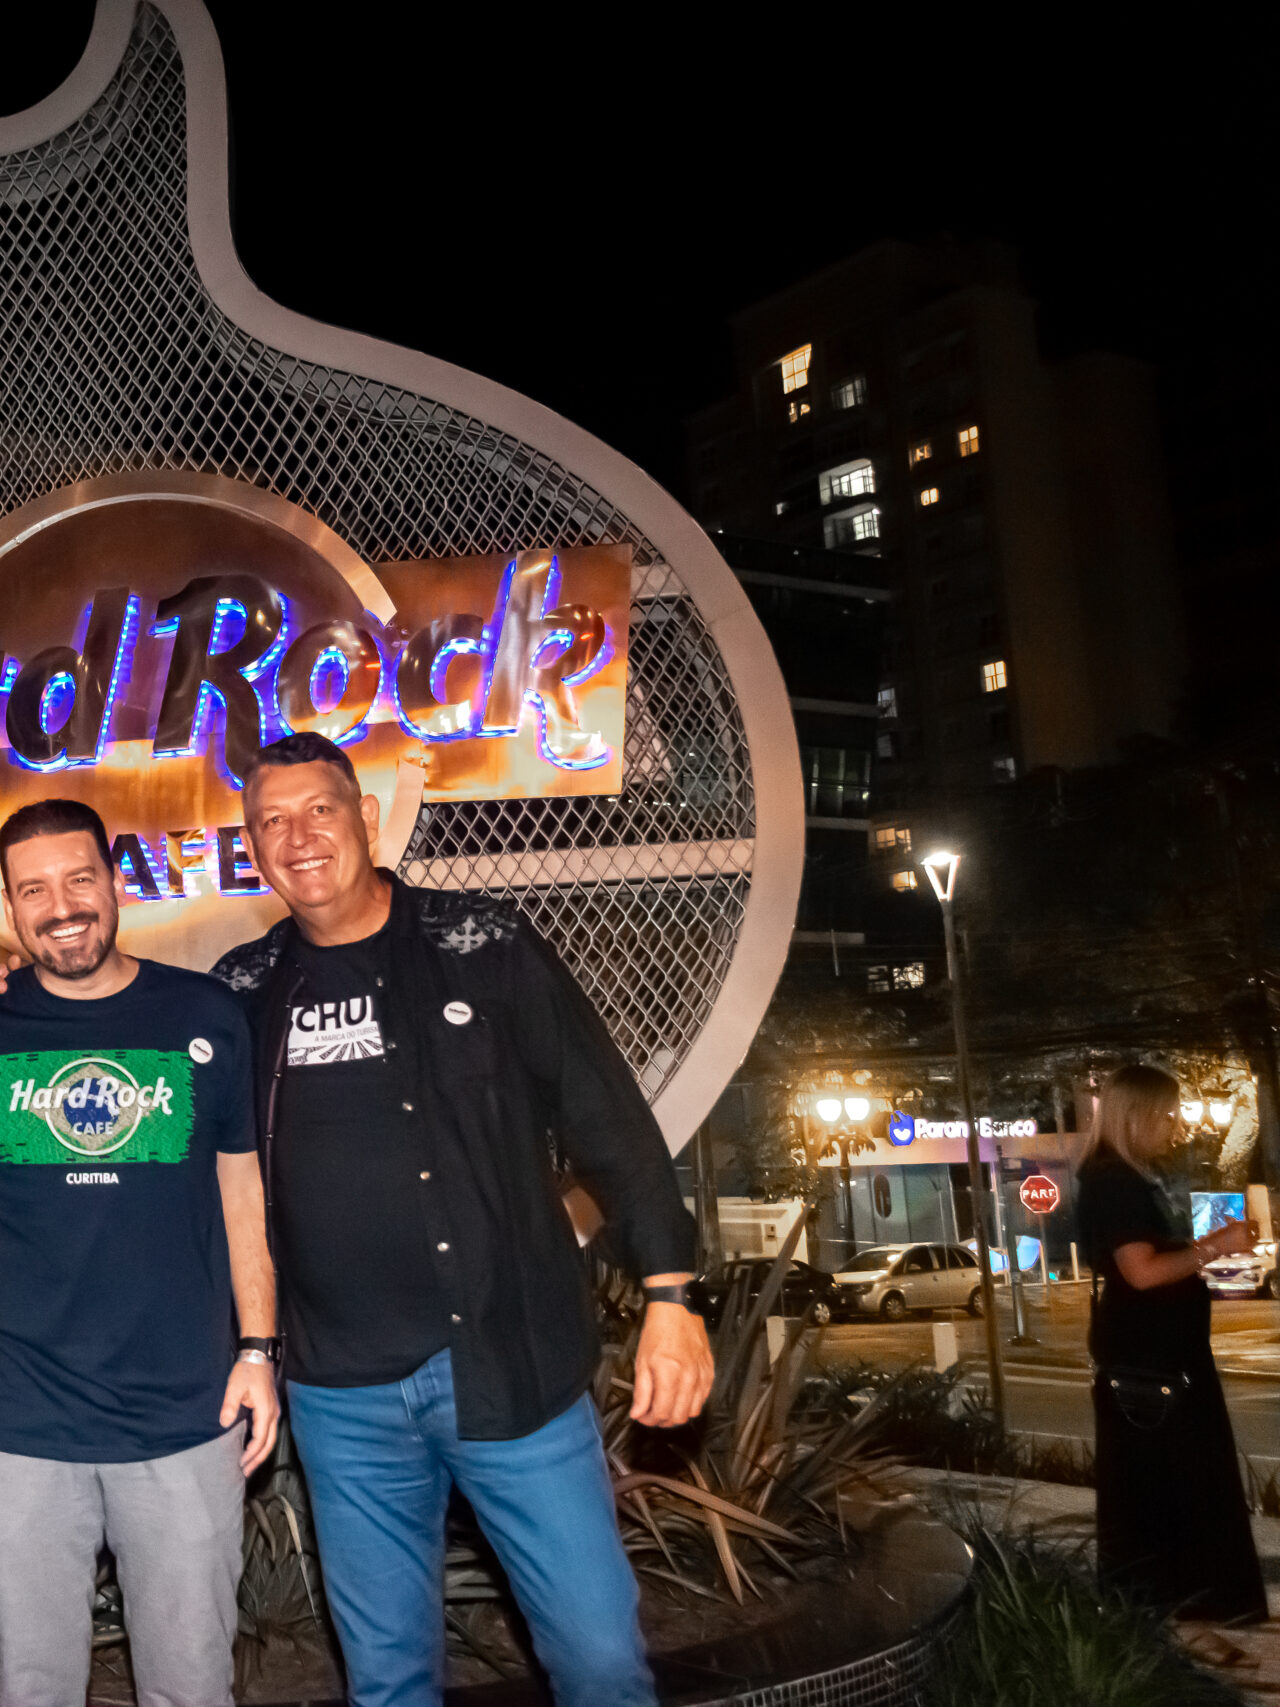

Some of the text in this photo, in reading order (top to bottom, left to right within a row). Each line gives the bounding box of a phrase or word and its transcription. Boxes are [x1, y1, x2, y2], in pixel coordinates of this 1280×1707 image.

[148, 550, 614, 790] Rock
[111, 826, 271, 901] AFE
[9, 1076, 173, 1116] Hard Rock
[73, 1121, 114, 1136] CAFE
[914, 1118, 978, 1139] Paran
[66, 1172, 120, 1184] CURITIBA
